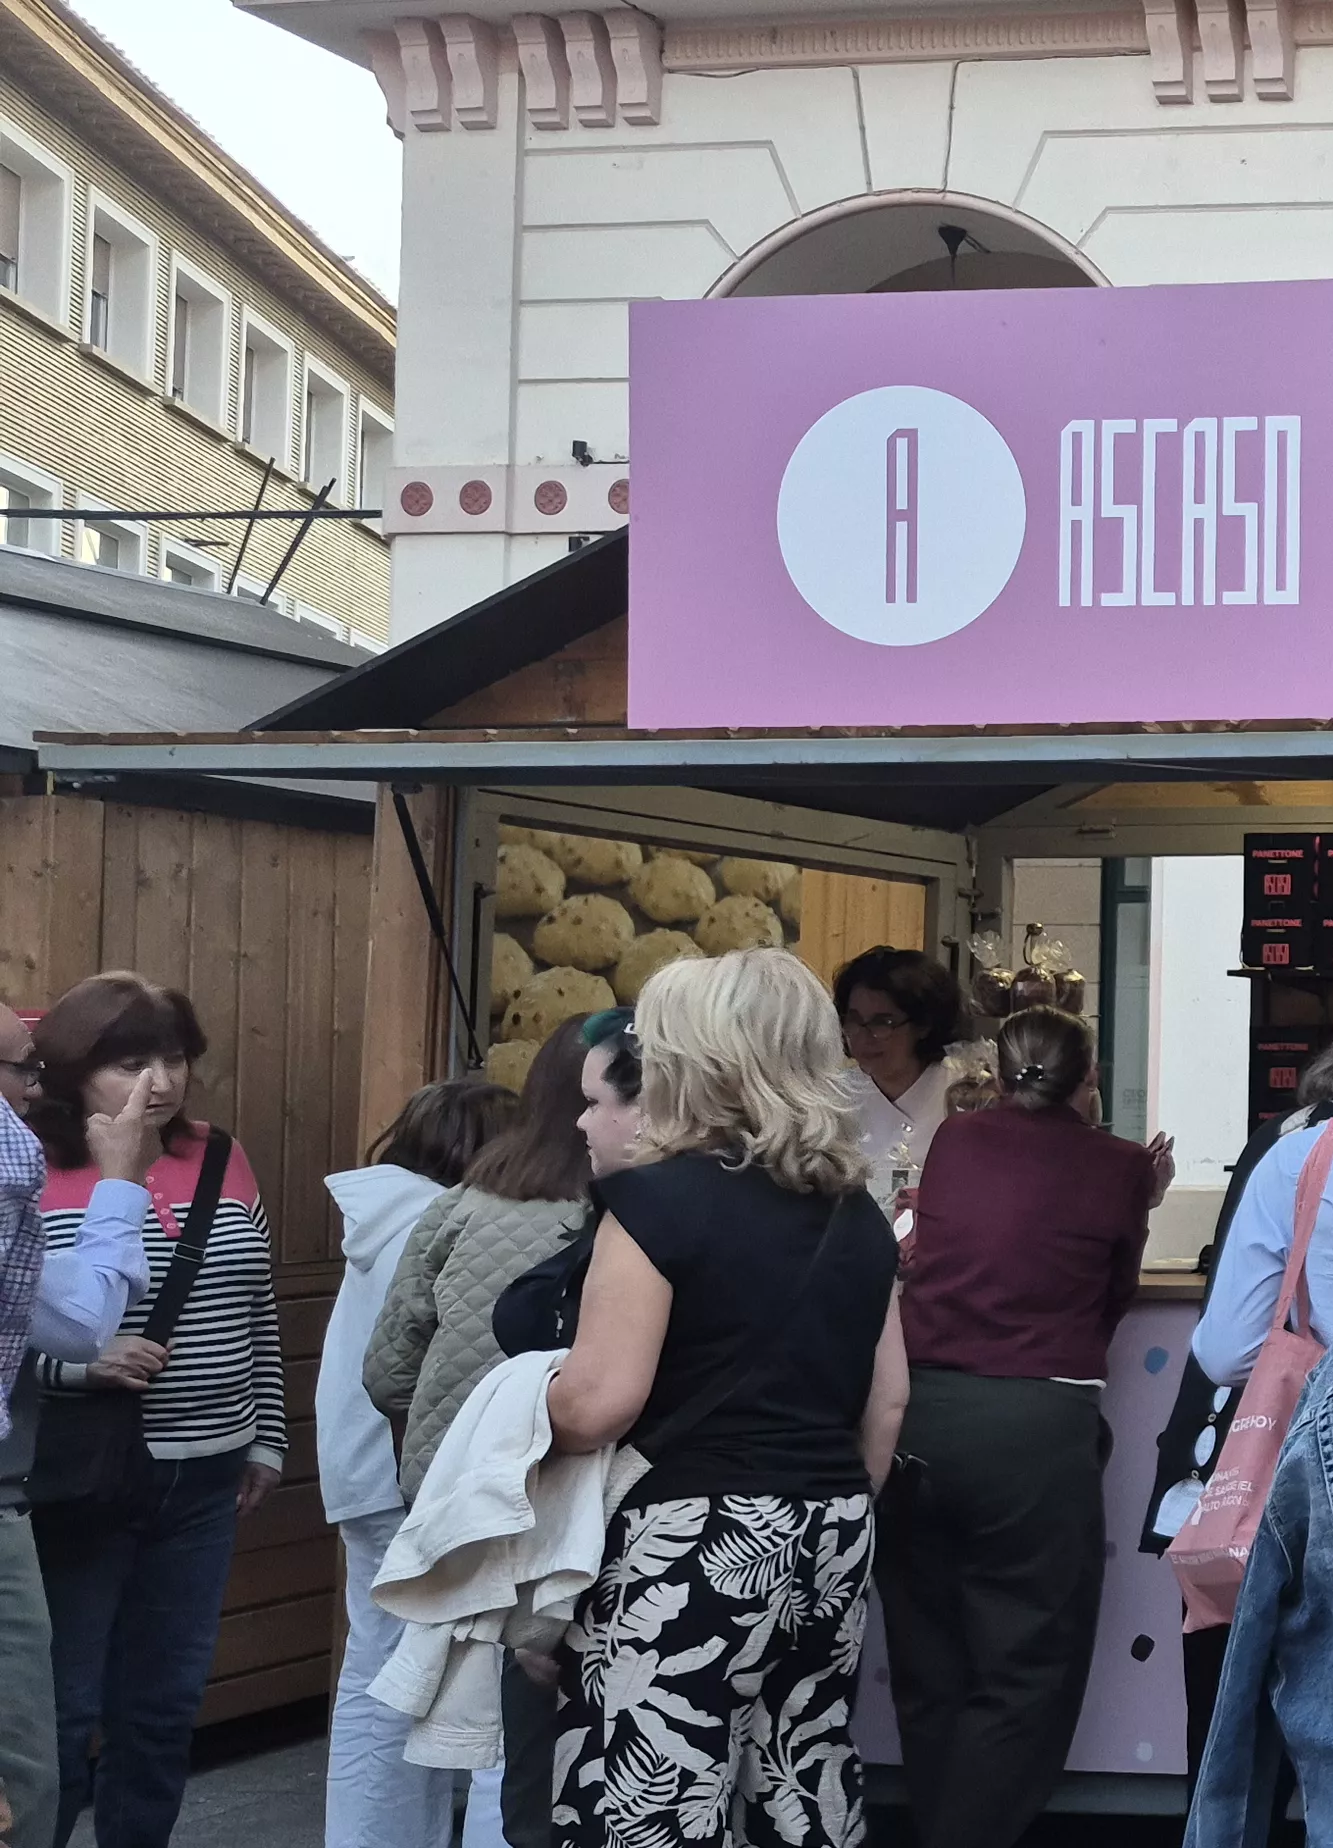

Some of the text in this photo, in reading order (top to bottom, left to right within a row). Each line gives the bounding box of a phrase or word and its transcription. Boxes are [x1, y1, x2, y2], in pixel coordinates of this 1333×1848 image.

[886, 415, 1301, 606] A ASCASO
[1252, 849, 1304, 859] PANETTONE
[1251, 919, 1303, 928] PANETTONE
